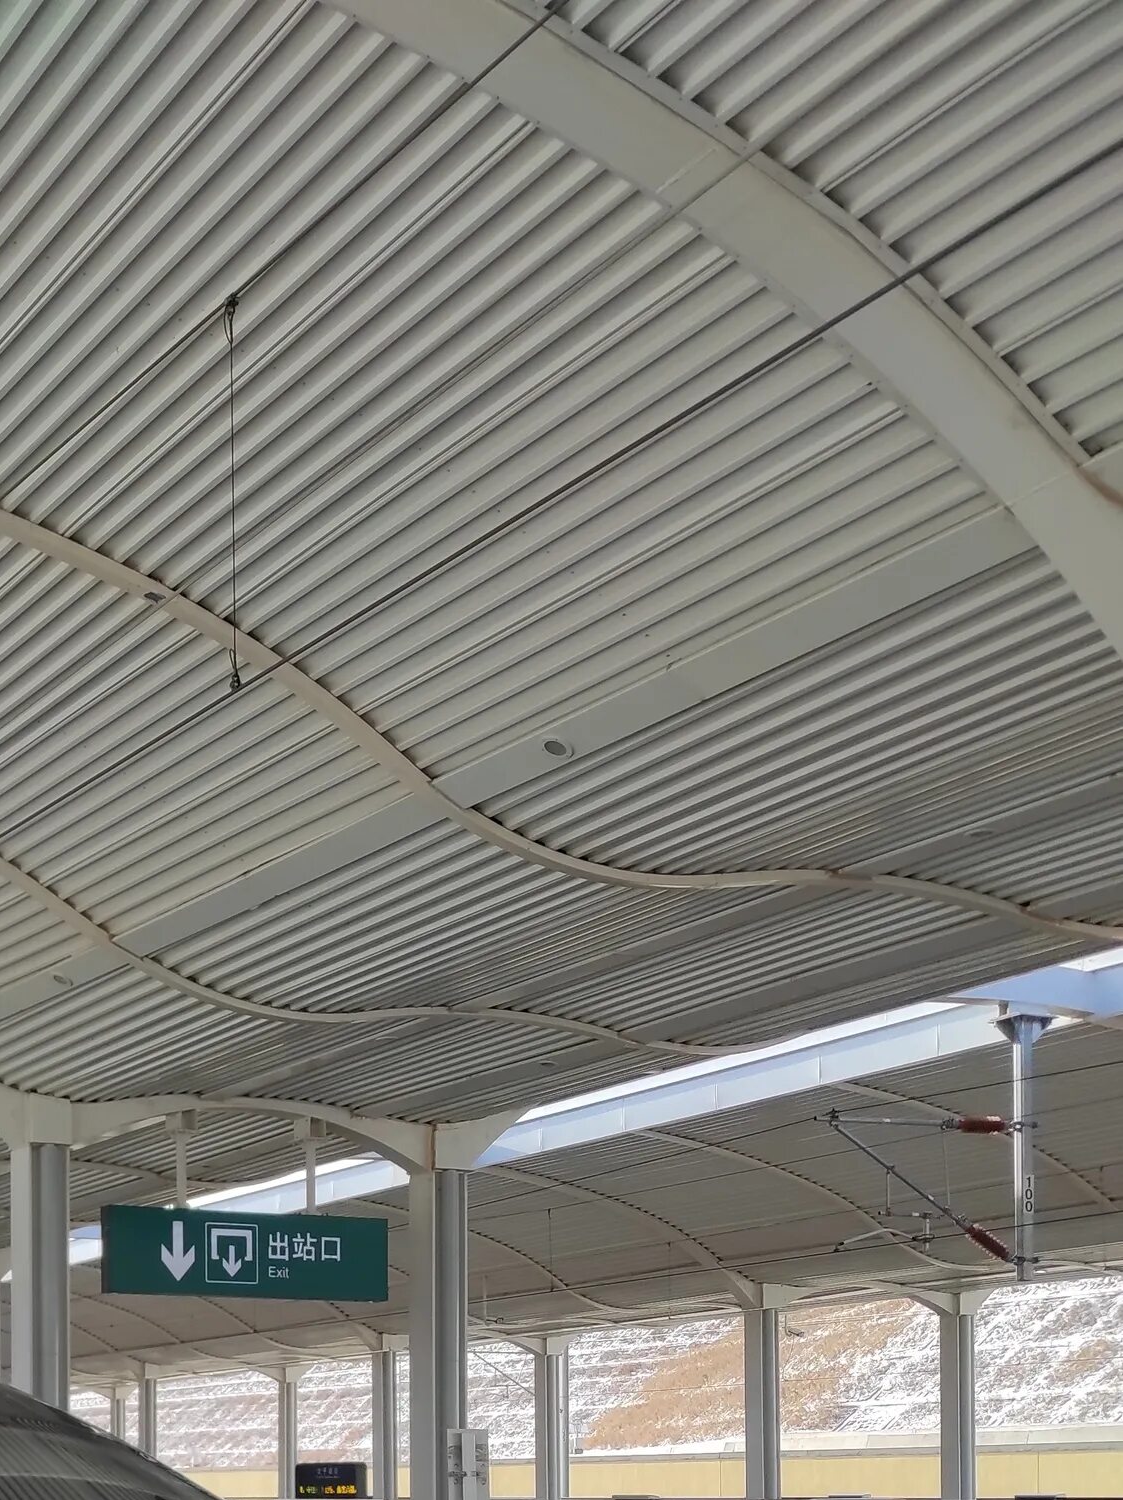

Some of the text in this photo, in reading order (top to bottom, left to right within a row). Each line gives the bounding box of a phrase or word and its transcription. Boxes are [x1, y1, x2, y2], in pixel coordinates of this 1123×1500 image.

[1025, 1176, 1033, 1212] 100
[268, 1231, 341, 1262] 出站口
[268, 1266, 289, 1279] Exit
